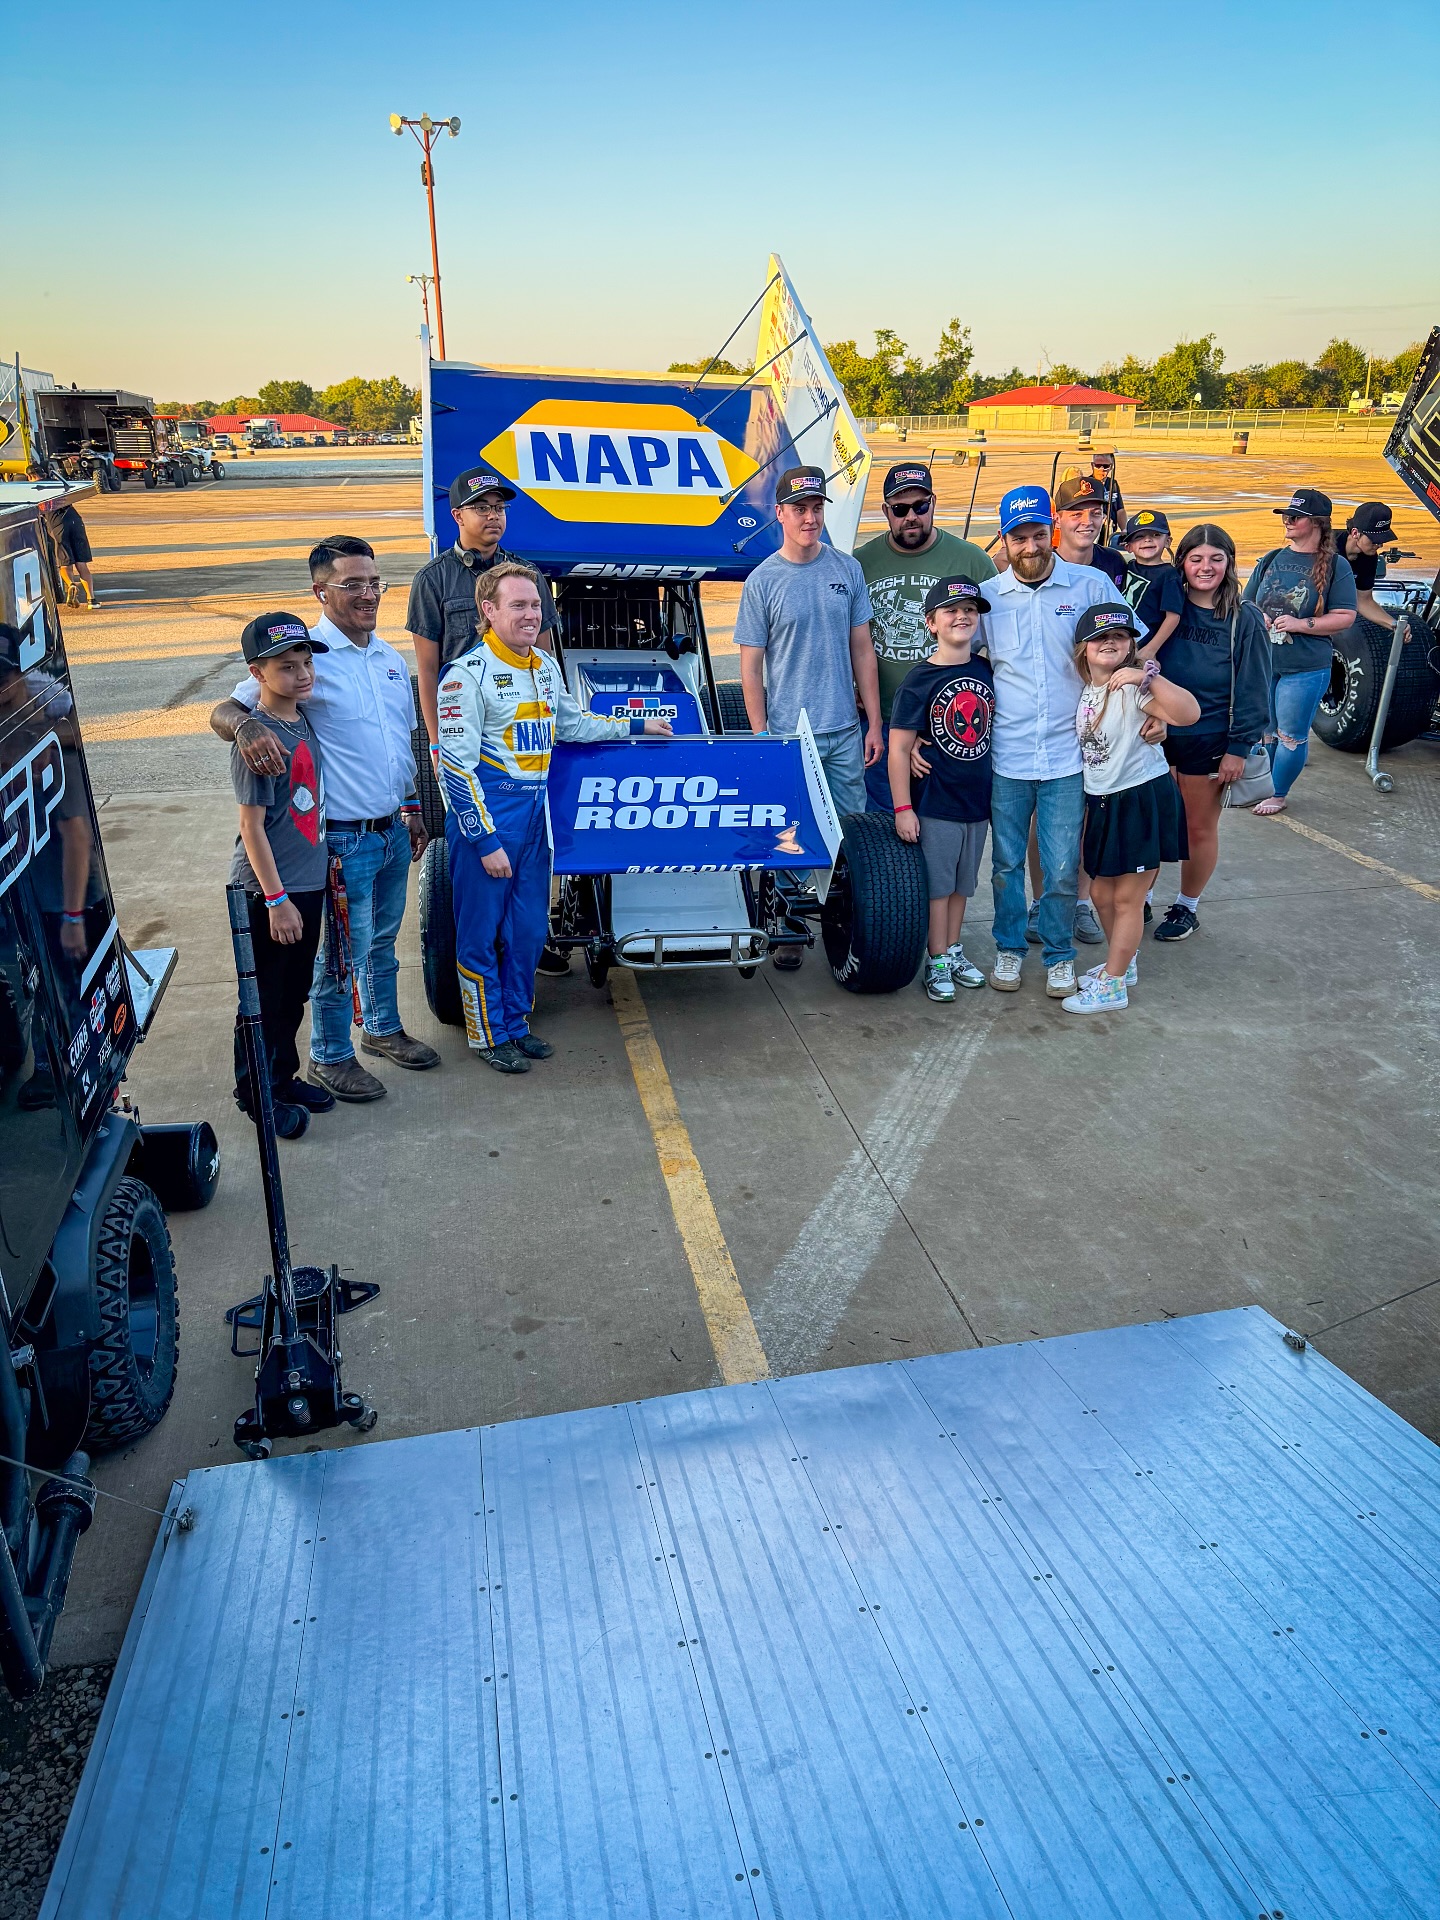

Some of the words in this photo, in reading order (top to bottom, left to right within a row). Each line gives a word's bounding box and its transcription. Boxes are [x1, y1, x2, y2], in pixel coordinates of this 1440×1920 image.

[530, 431, 724, 489] NAPA
[568, 563, 717, 581] SWEET
[869, 575, 906, 594] HIGH
[910, 575, 942, 586] LIM
[873, 641, 940, 661] RACING
[939, 688, 955, 705] I'M
[954, 681, 990, 701] SORRY,
[614, 706, 676, 719] Brumos
[516, 721, 553, 752] NAPA
[933, 716, 945, 736] DID
[947, 742, 987, 758] OFFEND
[577, 776, 739, 803] ROTO-
[574, 804, 787, 830] ROOTER
[462, 988, 481, 1041] CURB
